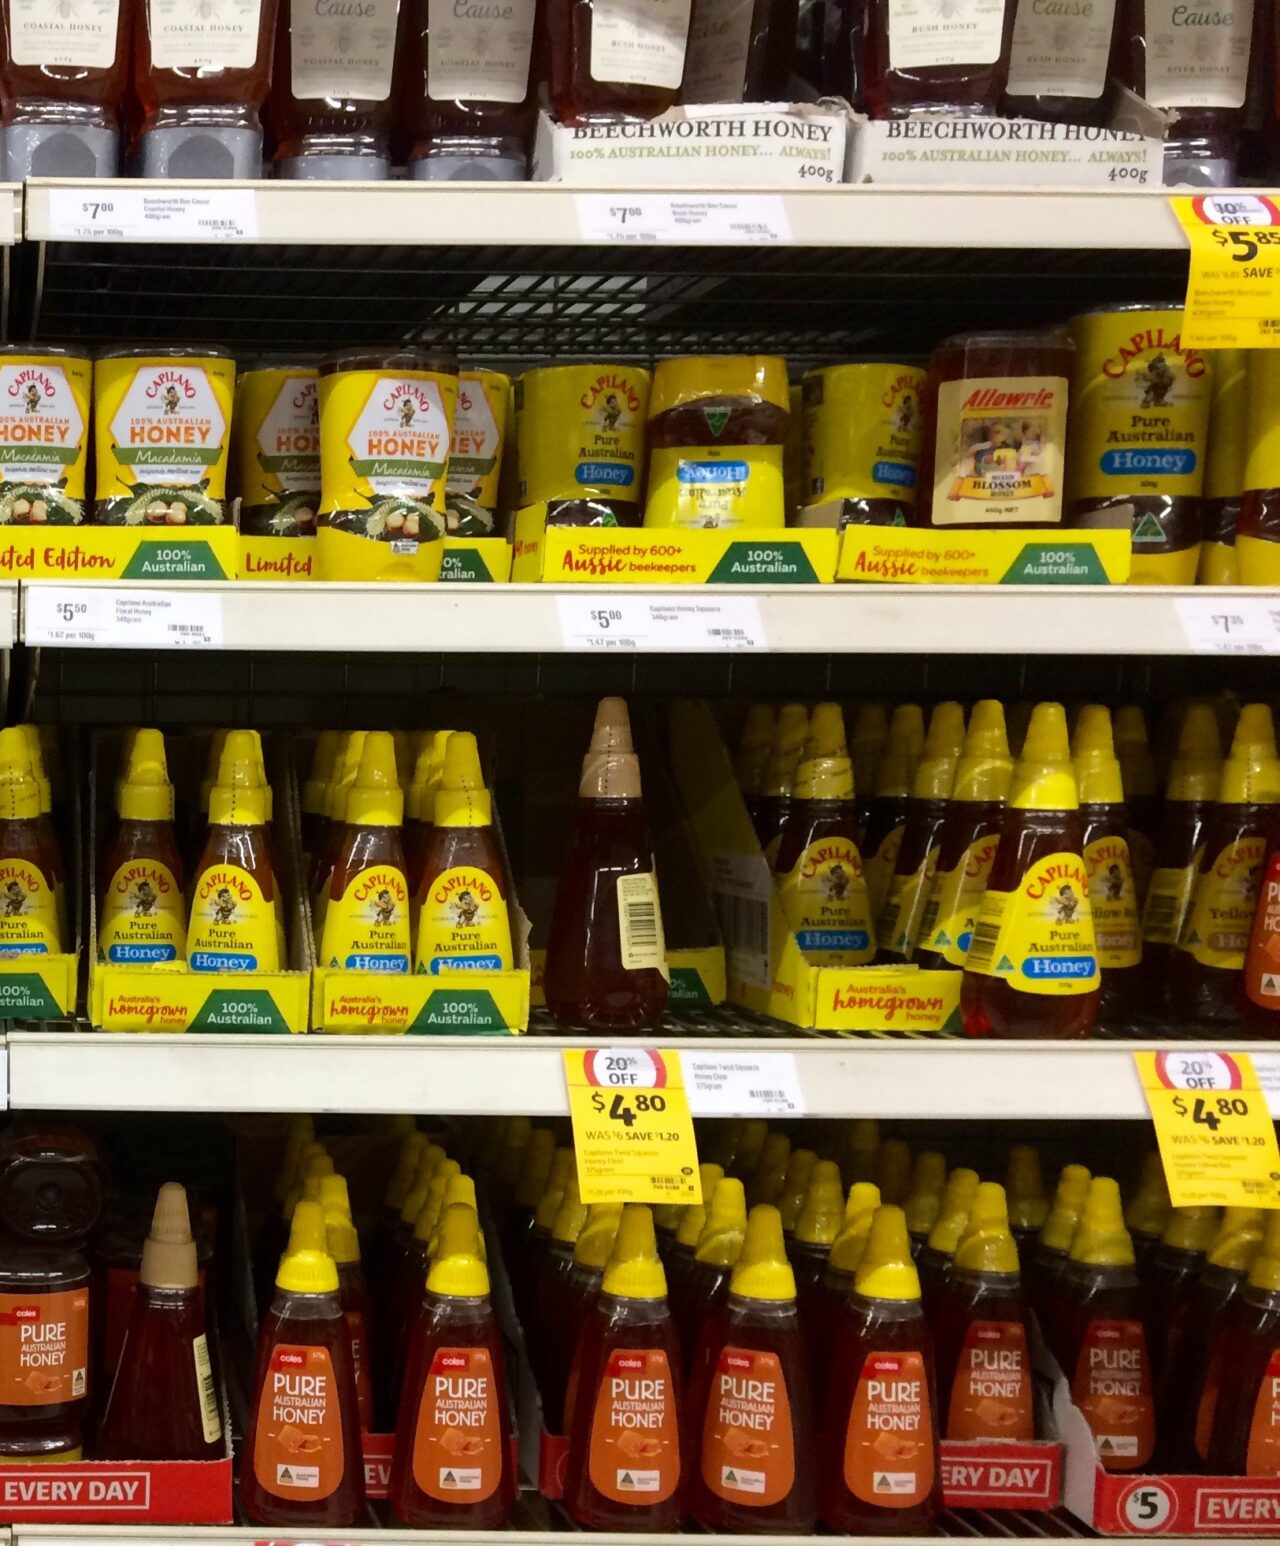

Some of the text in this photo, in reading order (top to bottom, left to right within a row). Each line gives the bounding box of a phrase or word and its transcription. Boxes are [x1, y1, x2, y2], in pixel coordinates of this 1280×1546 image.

[1171, 5, 1234, 28] Cause
[70, 23, 103, 32] HONEY
[572, 120, 833, 142] BEECHWORTH HONEY
[886, 121, 1057, 141] BEECHWORTH
[570, 147, 606, 160] 100%
[608, 145, 703, 160] AUSTRALIAN
[779, 147, 832, 162] ALWAYS!
[798, 165, 834, 182] 400g
[1108, 166, 1148, 183] 400g
[1243, 267, 1273, 278] SAVE
[1102, 329, 1207, 380] CAPILANO
[8, 370, 56, 398] CAPILANO
[383, 384, 430, 413] CAPILANO
[18, 416, 70, 425] AUSTRALIAN
[1130, 415, 1171, 429] Pure
[1106, 429, 1196, 443] Australian
[367, 439, 440, 457] HONEY
[0, 449, 61, 464] Macadamia
[1112, 452, 1188, 472] Honey
[972, 479, 1033, 491] BLOSSOM
[43, 545, 116, 569] Edition
[156, 549, 192, 561] 100%
[578, 544, 682, 557] Supplied by 600+
[747, 550, 783, 561] 100%
[872, 544, 976, 562] Supplied by 600+
[1039, 550, 1076, 563] 100%
[141, 561, 206, 573] Australian
[245, 551, 312, 574] Limited
[562, 550, 697, 574] Aussie beekeepers
[731, 561, 797, 573] Australian
[854, 551, 989, 578] Aussie beekeepers
[1023, 562, 1089, 575] Australian
[199, 873, 253, 902] CAPILANO
[208, 929, 236, 938] Pure
[194, 939, 253, 949] Australian
[195, 954, 250, 970] Honey
[109, 998, 188, 1023] homegrown
[222, 1002, 258, 1014] 100%
[207, 1012, 272, 1026] Australian
[608, 1072, 639, 1086] OFF
[1185, 1077, 1216, 1089] OFF
[625, 1131, 654, 1141] SAVE
[16, 1309, 37, 1318] coles
[20, 1323, 66, 1342] PURE
[20, 1341, 66, 1352] AUSTRALIAN
[20, 1351, 66, 1367] HONEY
[279, 1354, 303, 1364] coles
[273, 1373, 326, 1397] PURE
[273, 1395, 326, 1408] AUSTRALIAN
[272, 1406, 326, 1425] HONEY
[989, 1469, 1040, 1488] DAY
[4, 1481, 139, 1501] EVERY DAY
[1132, 1491, 1158, 1520] $5
[1206, 1497, 1280, 1519] EVERY
